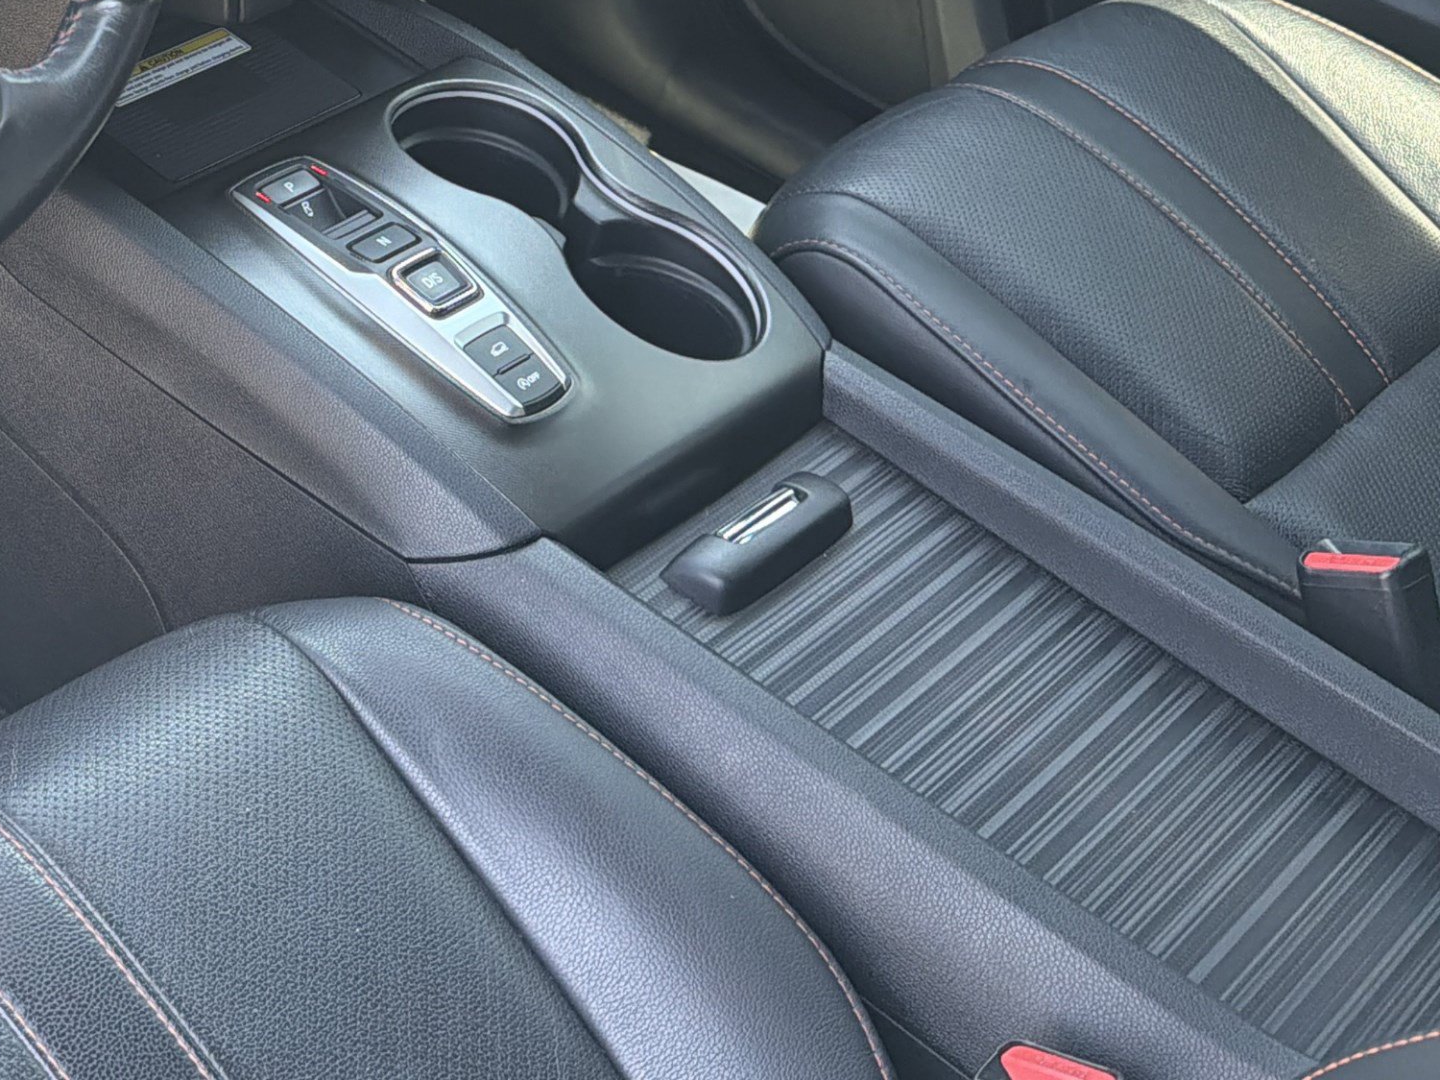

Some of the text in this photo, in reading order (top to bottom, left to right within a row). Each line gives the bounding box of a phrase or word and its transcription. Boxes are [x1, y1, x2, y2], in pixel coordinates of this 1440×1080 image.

[148, 49, 184, 67] CAUTION
[283, 181, 296, 193] P
[375, 236, 392, 247] N
